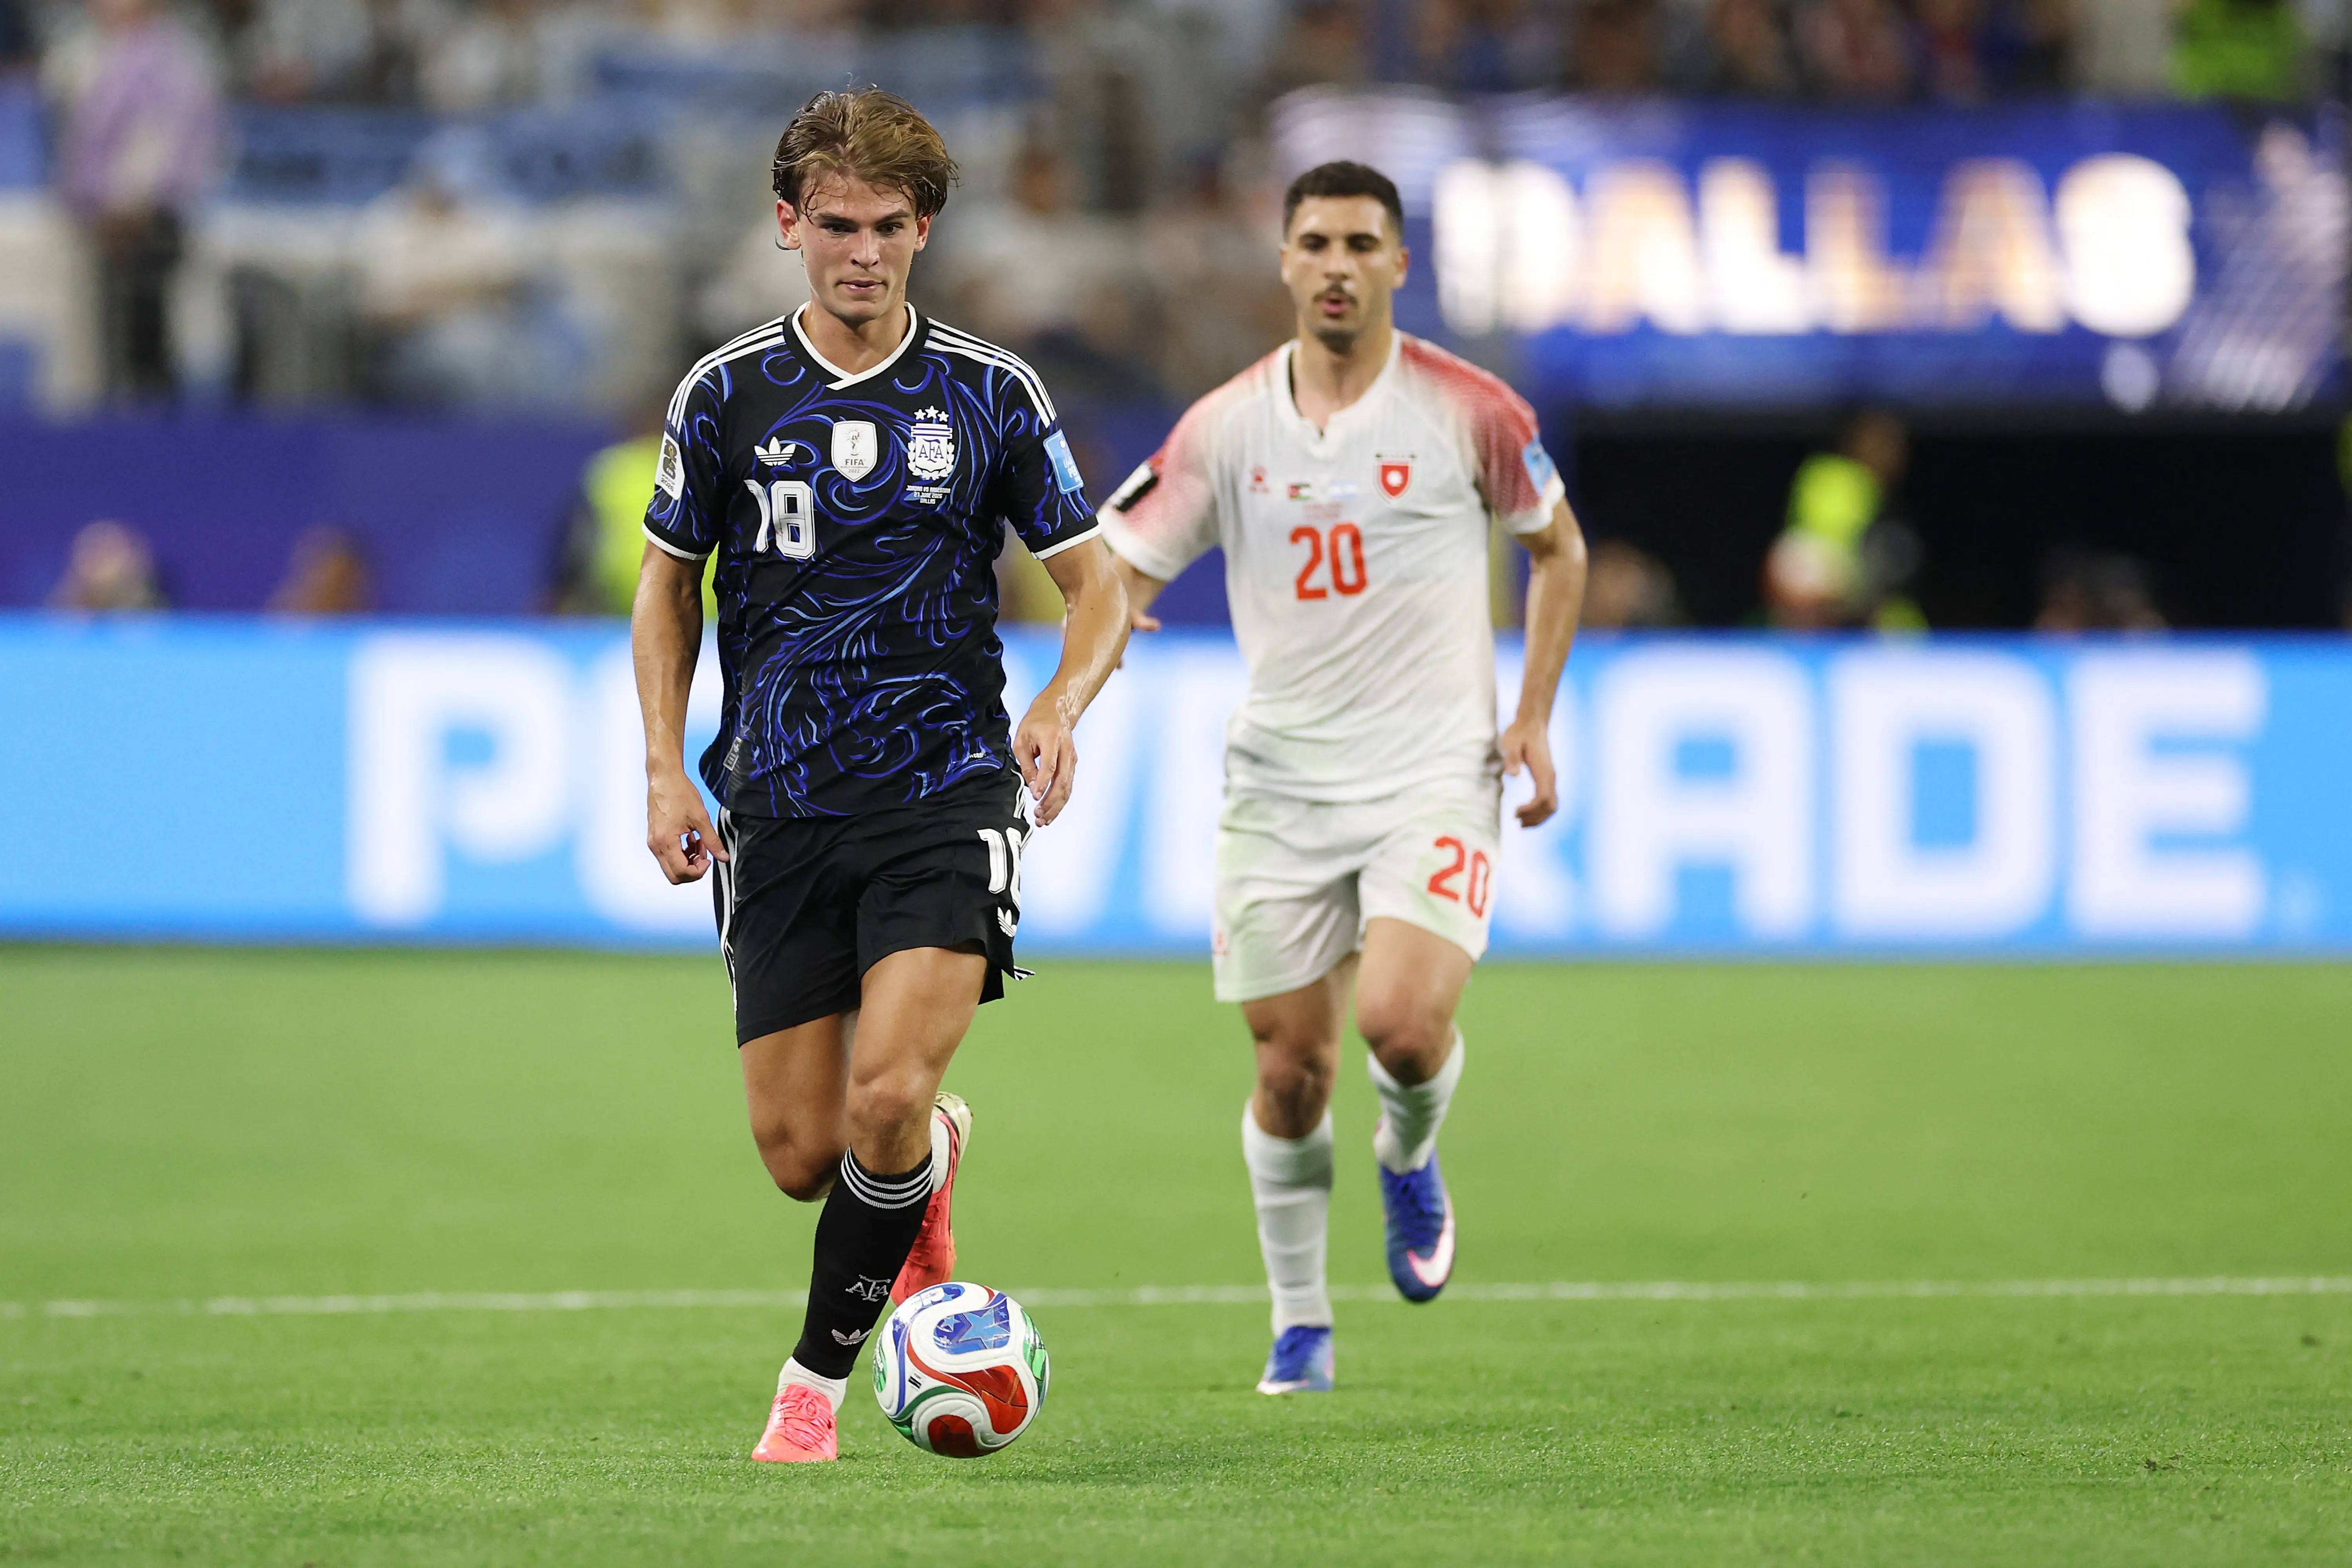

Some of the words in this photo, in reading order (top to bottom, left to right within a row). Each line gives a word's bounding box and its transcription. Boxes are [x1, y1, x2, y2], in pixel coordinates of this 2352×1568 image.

[1433, 157, 2196, 337] DALLAS
[661, 477, 674, 492] 2026
[918, 438, 944, 463] AFA
[743, 479, 815, 559] 18
[1289, 522, 1368, 601] 20
[347, 629, 2268, 941] PADE
[1428, 836, 1490, 918] 20
[845, 1274, 891, 1302] AFA
